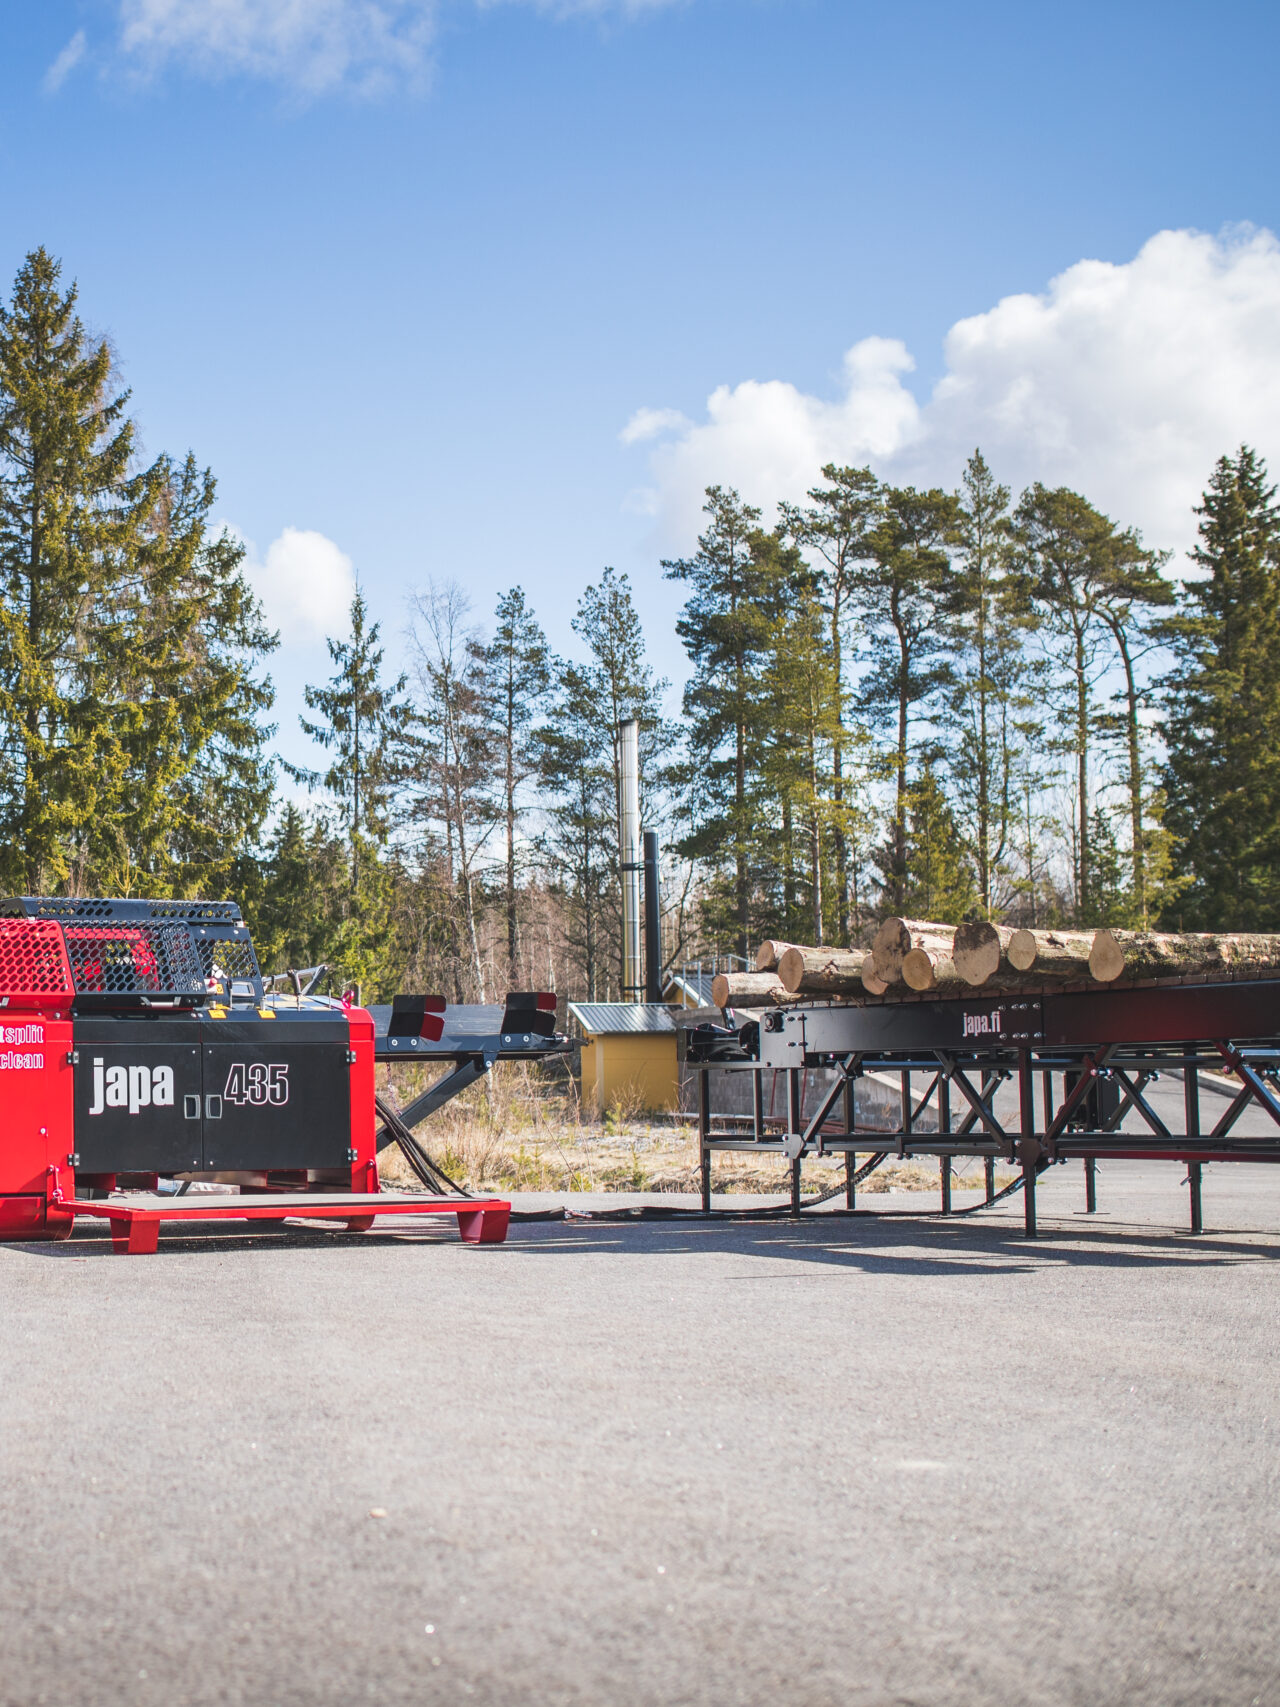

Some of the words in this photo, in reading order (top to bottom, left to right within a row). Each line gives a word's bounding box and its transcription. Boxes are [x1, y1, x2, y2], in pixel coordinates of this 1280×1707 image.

[962, 1011, 1000, 1037] japa.fi
[89, 1057, 175, 1115] japa
[223, 1063, 289, 1105] 435
